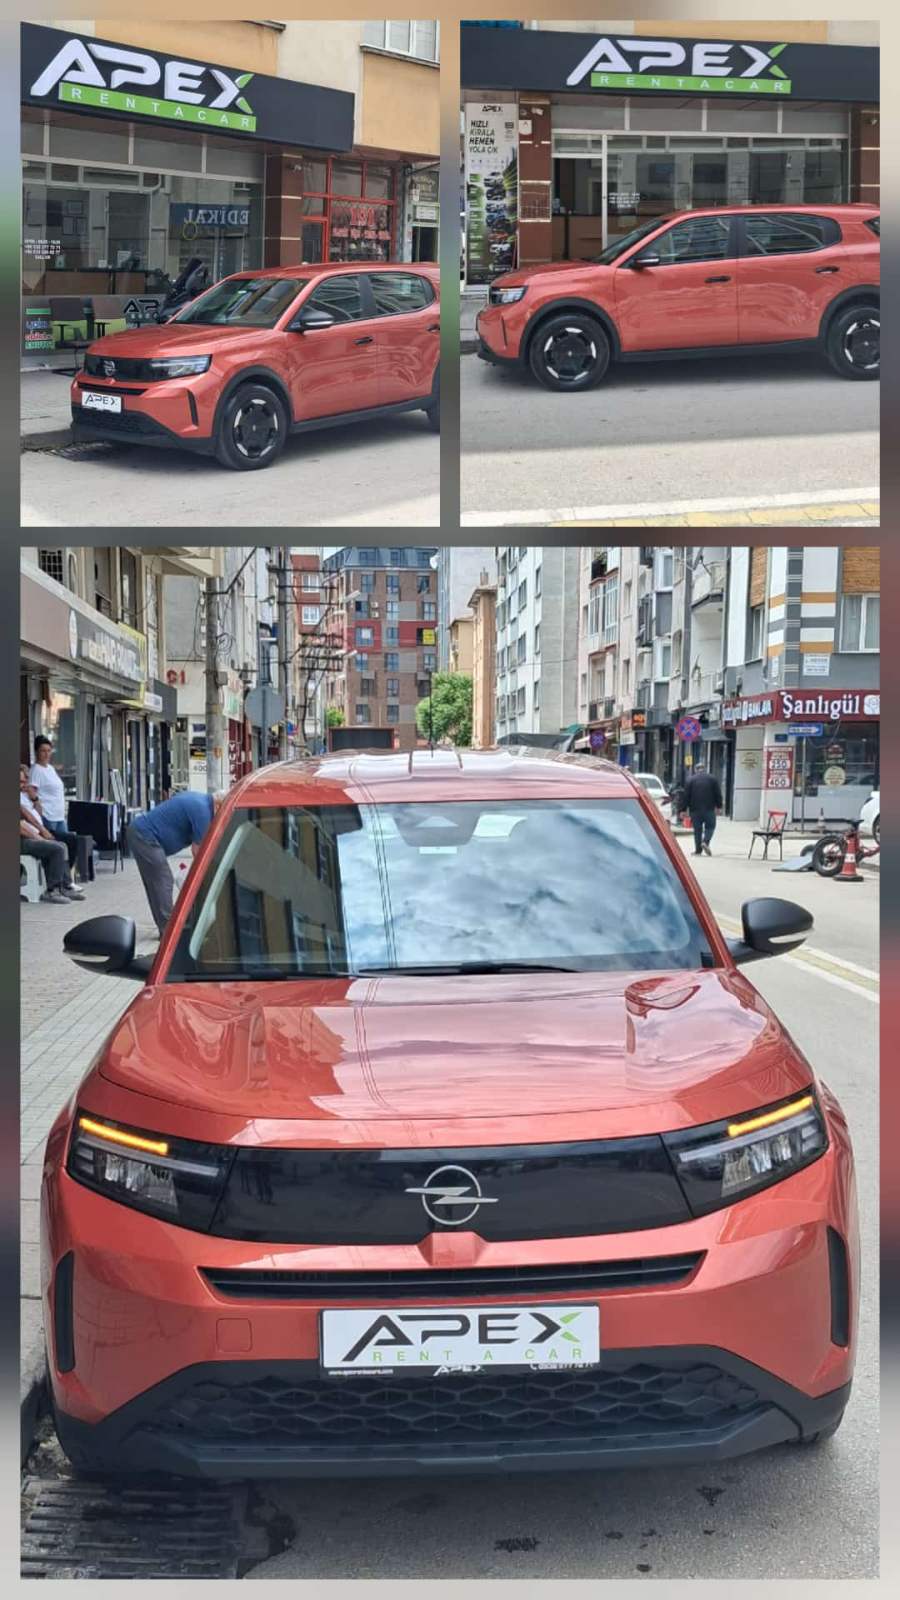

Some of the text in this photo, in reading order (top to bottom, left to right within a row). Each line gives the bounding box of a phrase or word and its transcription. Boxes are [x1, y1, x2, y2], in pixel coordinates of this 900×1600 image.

[566, 38, 788, 87] APEX
[30, 39, 254, 114] APEX
[85, 394, 116, 406] APEX
[783, 694, 860, 719] Şanlıgül
[341, 1311, 583, 1362] APEX
[372, 1348, 583, 1361] RENT A CAR
[433, 1364, 485, 1377] APEX
